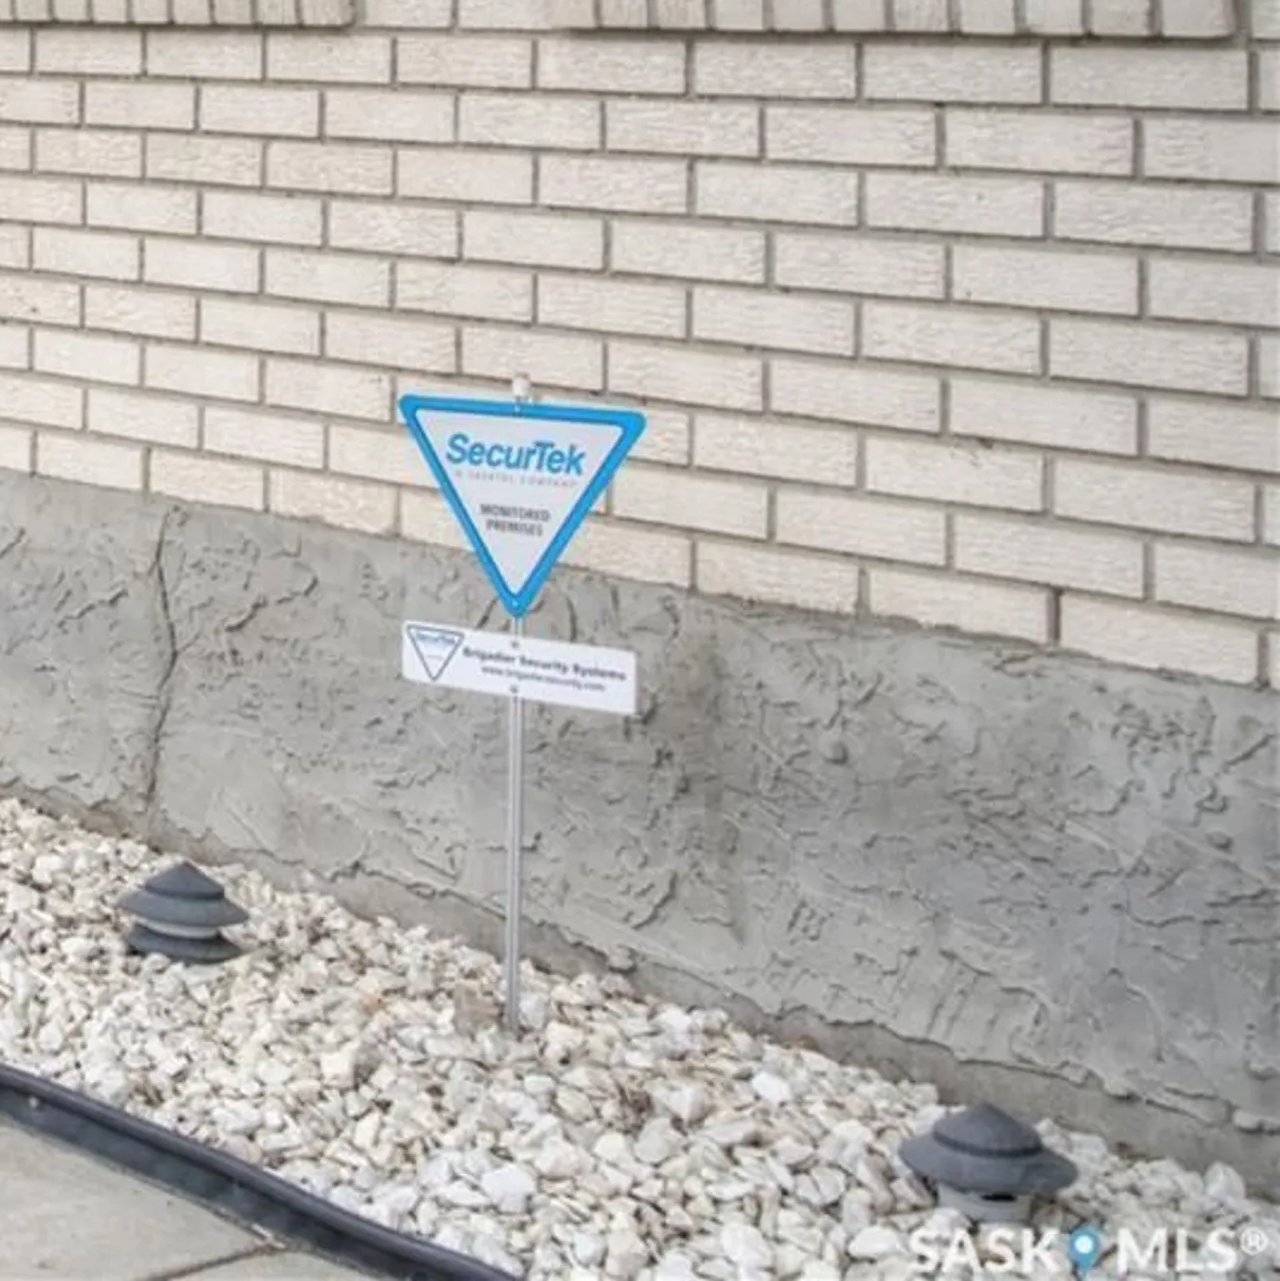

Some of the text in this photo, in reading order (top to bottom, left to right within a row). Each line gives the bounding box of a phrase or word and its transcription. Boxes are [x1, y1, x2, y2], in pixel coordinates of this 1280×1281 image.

[445, 432, 587, 477] SecurTek
[480, 503, 551, 522] MONITORED
[486, 519, 544, 537] PREMISES
[519, 655, 569, 674] Security
[573, 663, 627, 682] Systems
